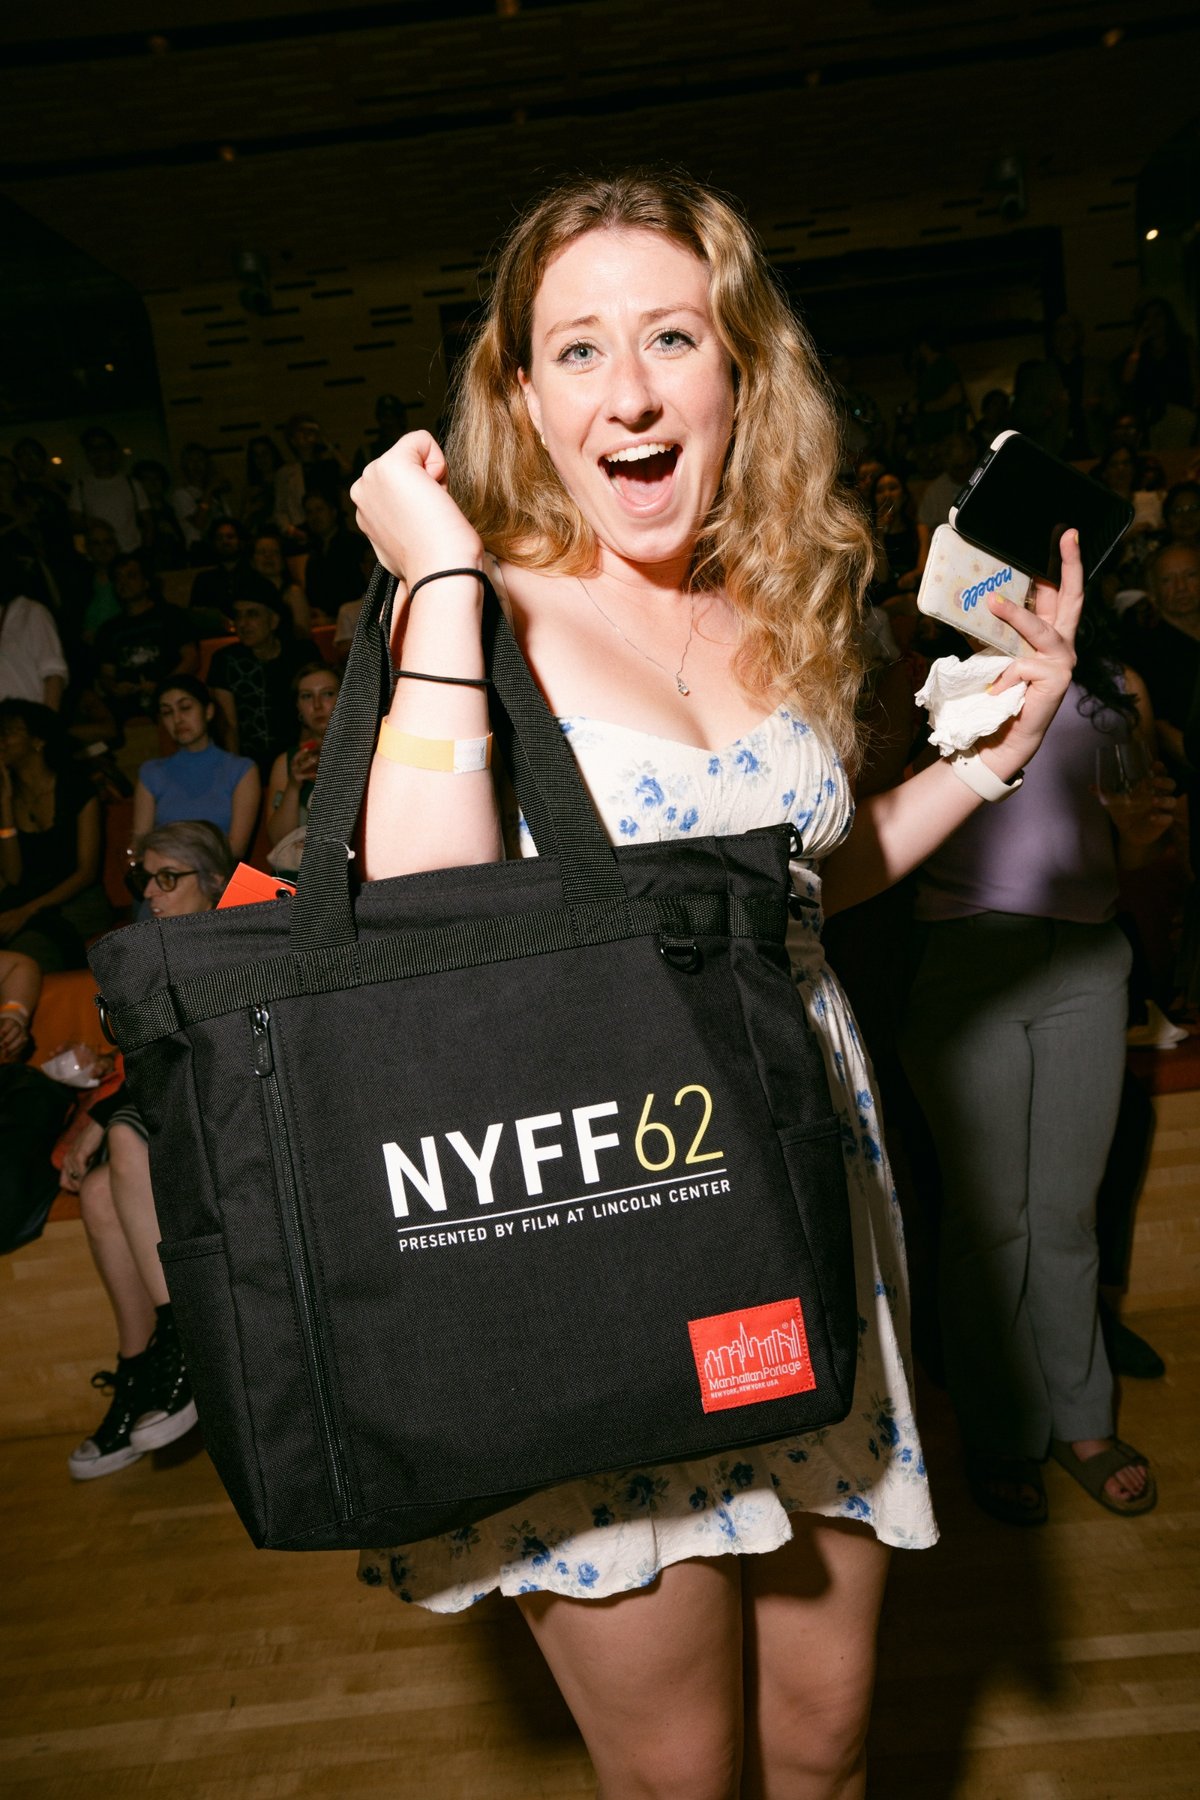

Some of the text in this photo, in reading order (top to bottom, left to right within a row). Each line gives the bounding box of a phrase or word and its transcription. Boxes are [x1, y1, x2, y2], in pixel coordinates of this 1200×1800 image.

[398, 1178, 732, 1253] PRESENTED BY FILM AT LINCOLN CENTER
